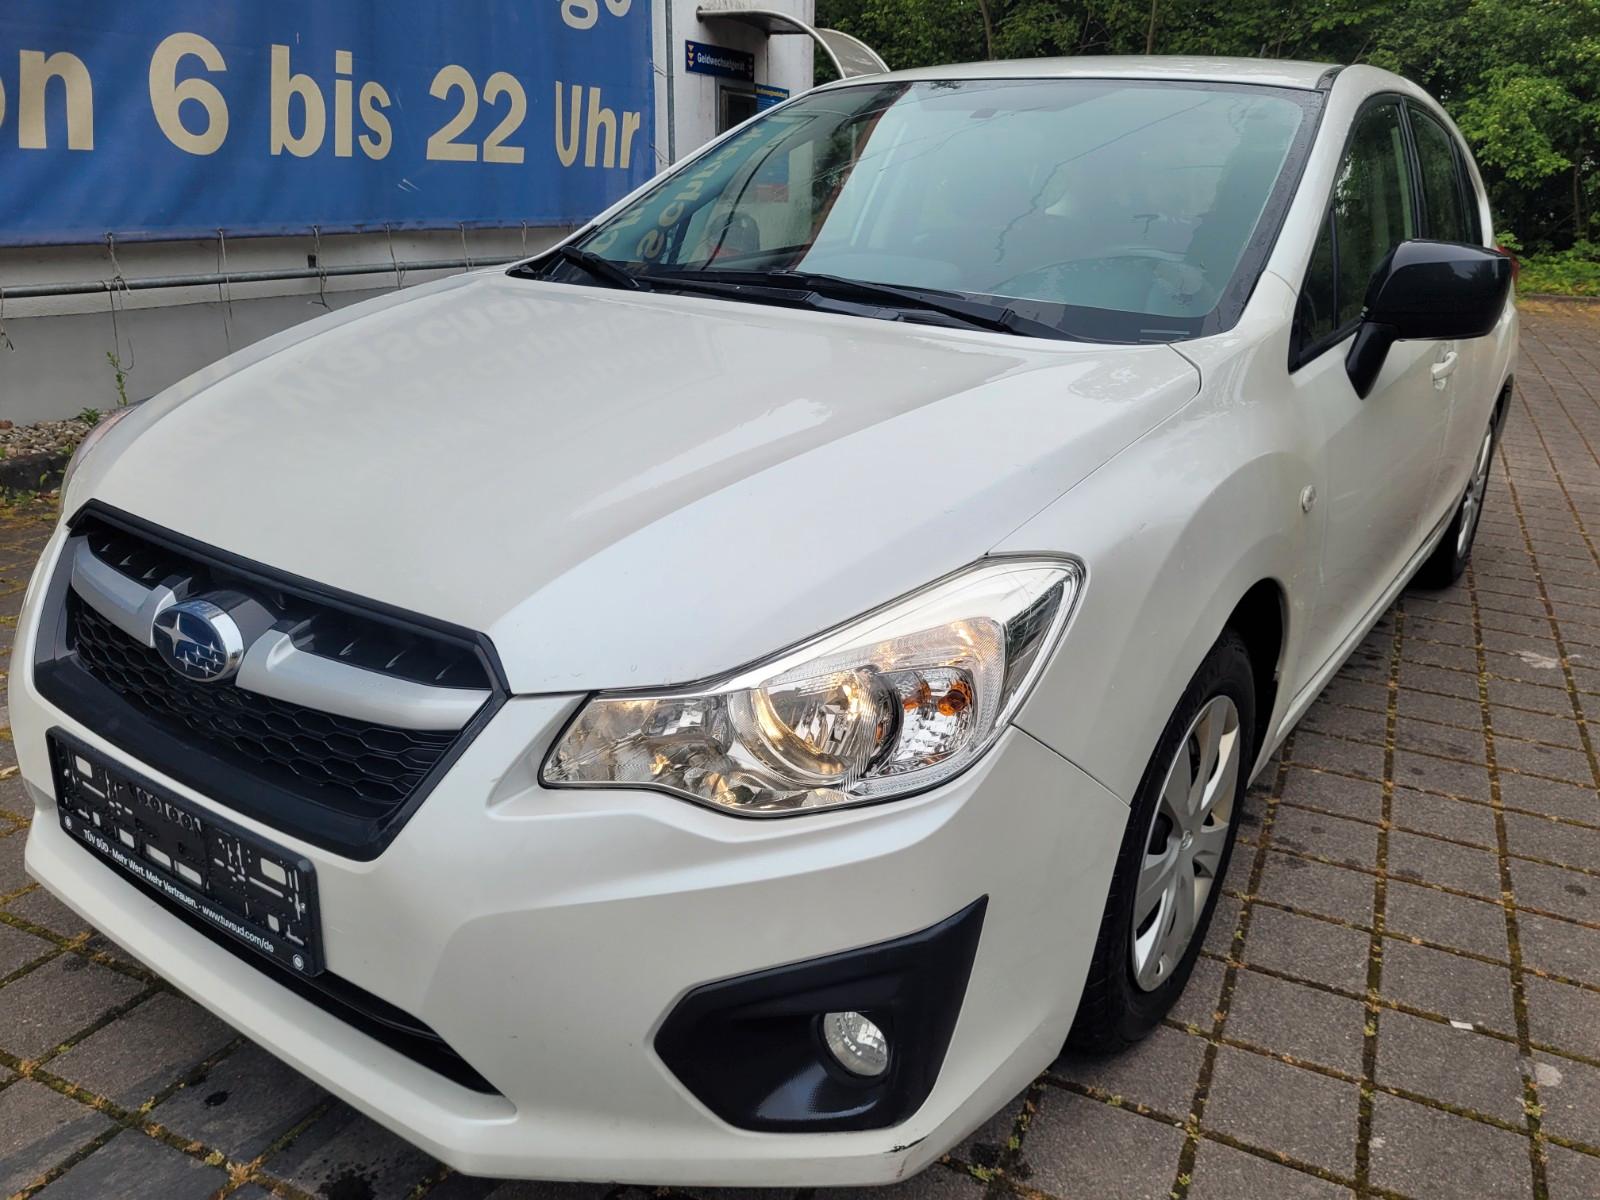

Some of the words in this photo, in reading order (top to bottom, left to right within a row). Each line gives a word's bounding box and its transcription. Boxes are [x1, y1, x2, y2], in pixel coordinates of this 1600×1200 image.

[0, 49, 94, 151] n
[149, 32, 229, 156] 6
[270, 44, 393, 161] bis
[426, 64, 527, 164] 22
[555, 81, 640, 169] Uhr
[83, 829, 96, 843] TÜV
[96, 838, 109, 853] SÜD
[112, 848, 128, 866] Mehr
[145, 869, 162, 887] Mehr
[202, 905, 275, 953] www.tuvsud.com/de
